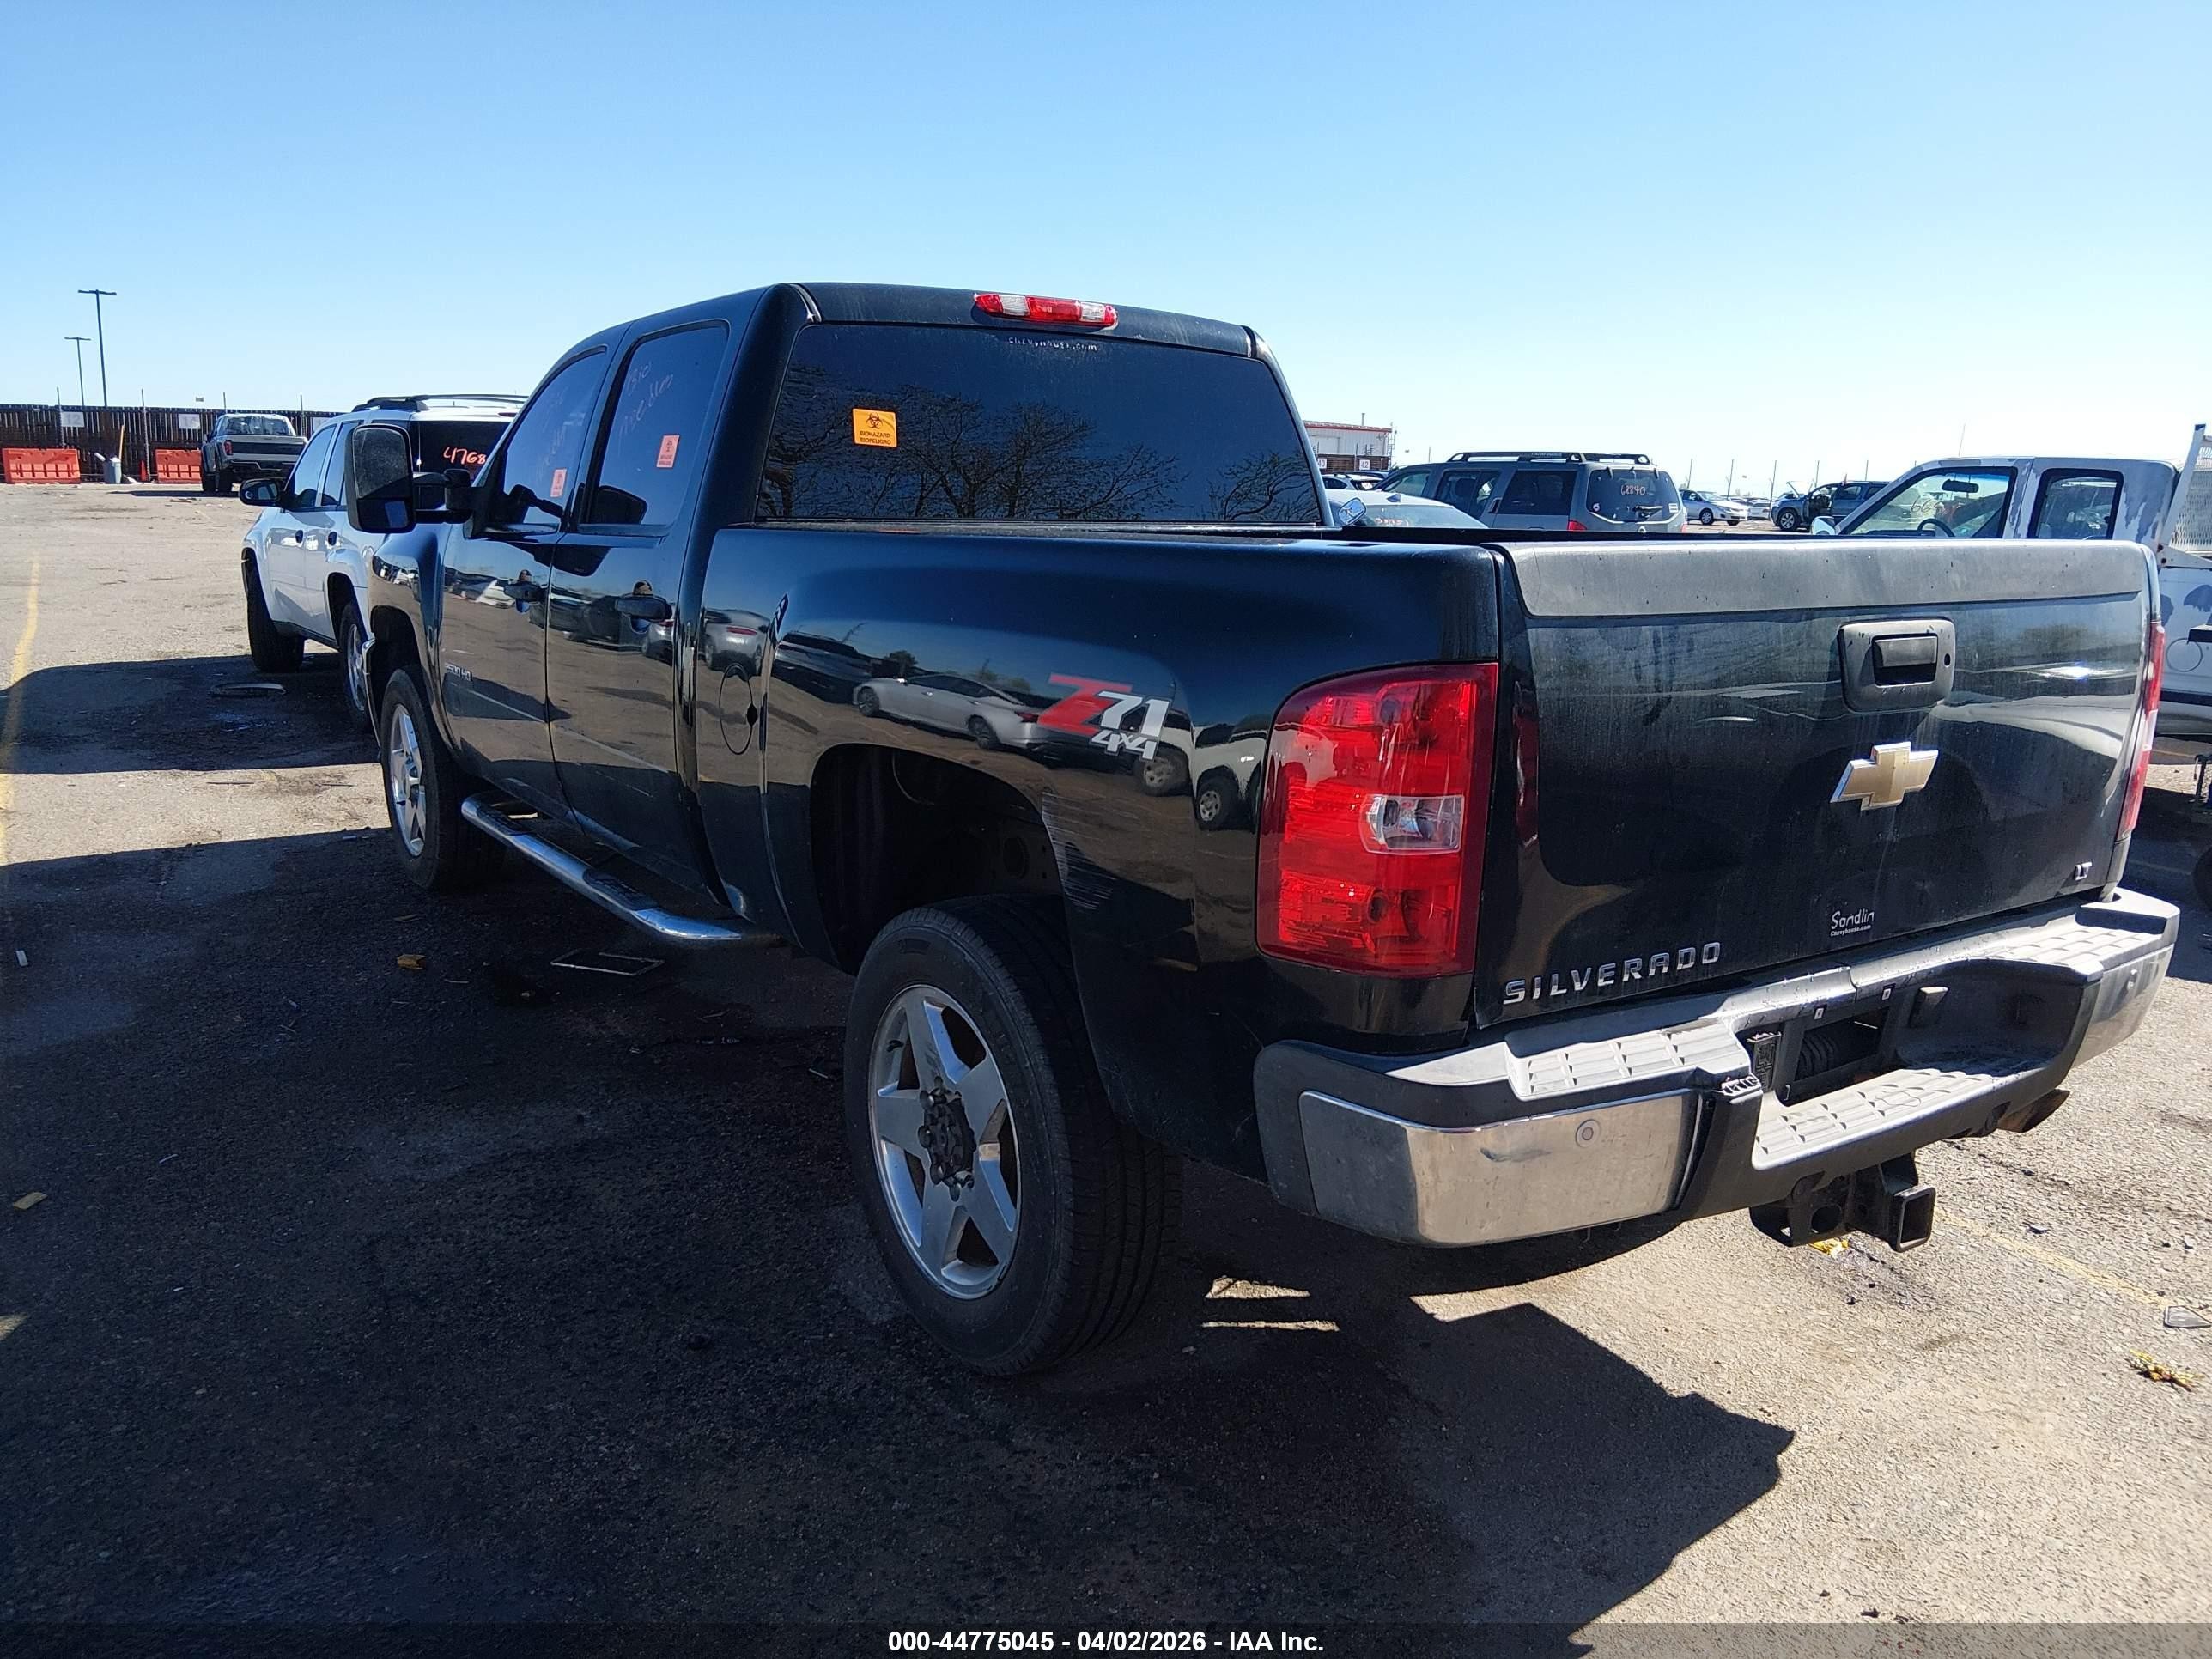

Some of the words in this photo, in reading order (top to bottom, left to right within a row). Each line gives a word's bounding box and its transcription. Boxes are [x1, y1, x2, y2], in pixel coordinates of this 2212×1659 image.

[1037, 672, 1170, 738] Z71
[1831, 908, 1875, 930] Sandlin
[1503, 941, 1721, 1006] SILVERADO
